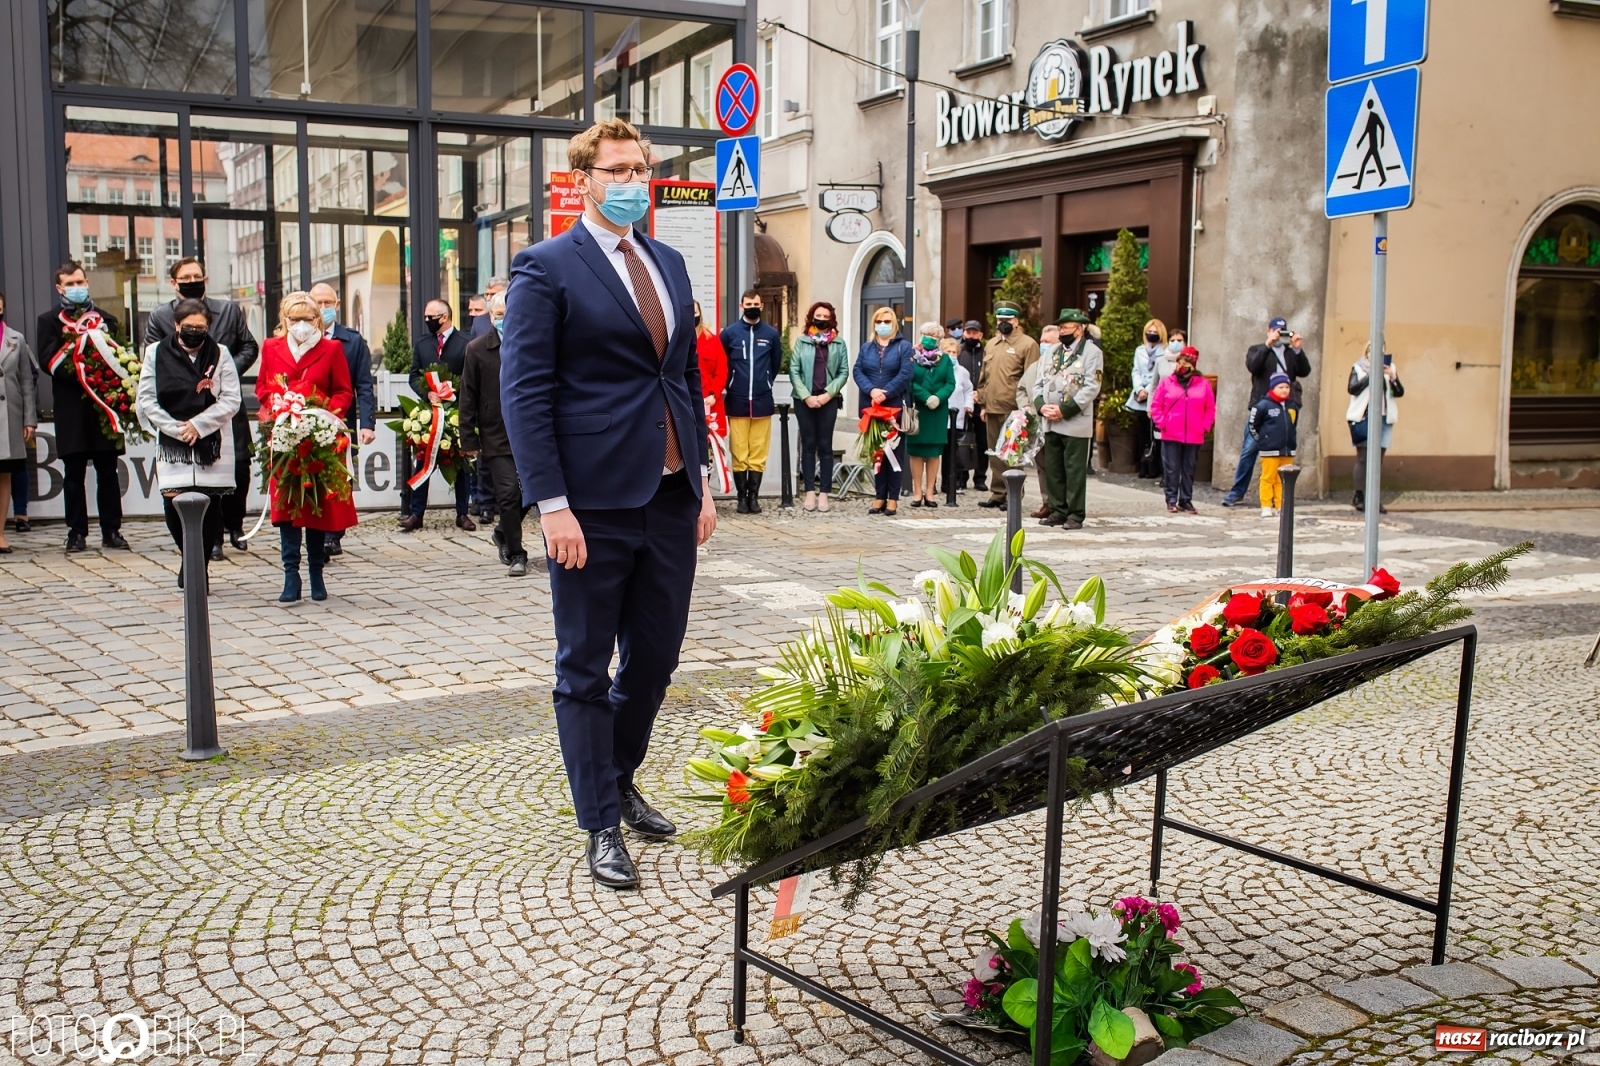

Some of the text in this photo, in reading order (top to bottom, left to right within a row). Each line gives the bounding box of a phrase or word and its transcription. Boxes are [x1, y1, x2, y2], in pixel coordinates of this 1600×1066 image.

[936, 20, 1201, 148] Browar Rynek
[552, 185, 570, 197] Druga
[663, 186, 709, 200] LUNCH
